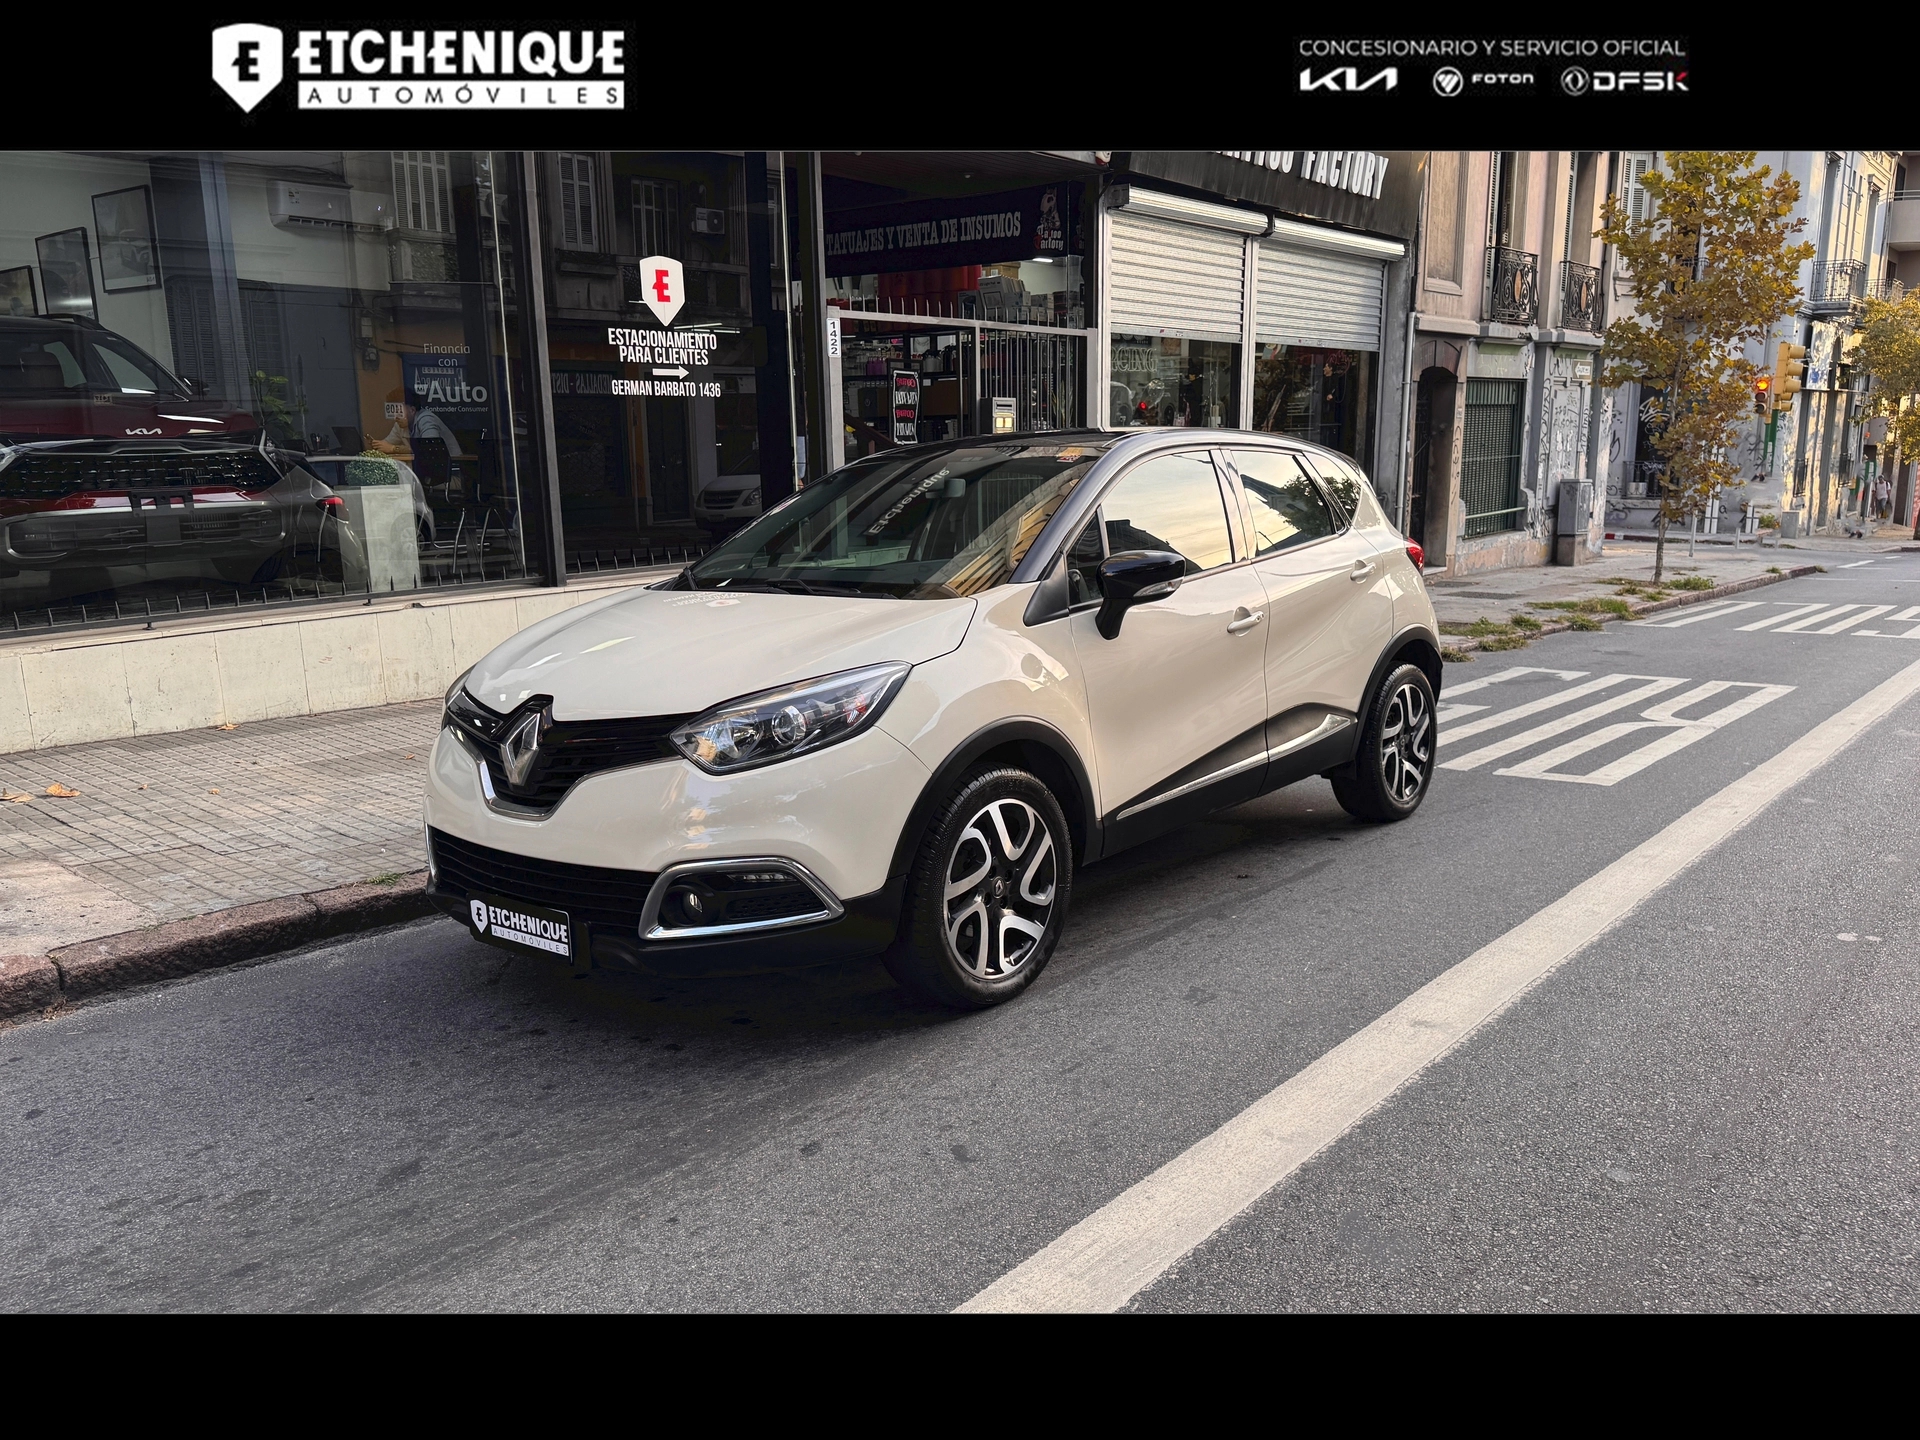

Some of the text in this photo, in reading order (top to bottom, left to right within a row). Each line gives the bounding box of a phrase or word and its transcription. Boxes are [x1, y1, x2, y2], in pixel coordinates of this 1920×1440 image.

[1301, 151, 1389, 200] FACTORY
[826, 211, 1021, 256] TATUAJES Y VENTA DE INSUMOS
[423, 343, 471, 354] Financia
[608, 328, 717, 350] ESTACIONAMIENTO
[830, 321, 838, 355] 1422
[438, 358, 458, 367] con
[619, 346, 709, 366] PARA CLIENTES
[427, 380, 488, 403] Auto
[611, 380, 721, 398] GERMAN BARBATO 1436
[488, 905, 568, 943] ETCHENIQUE
